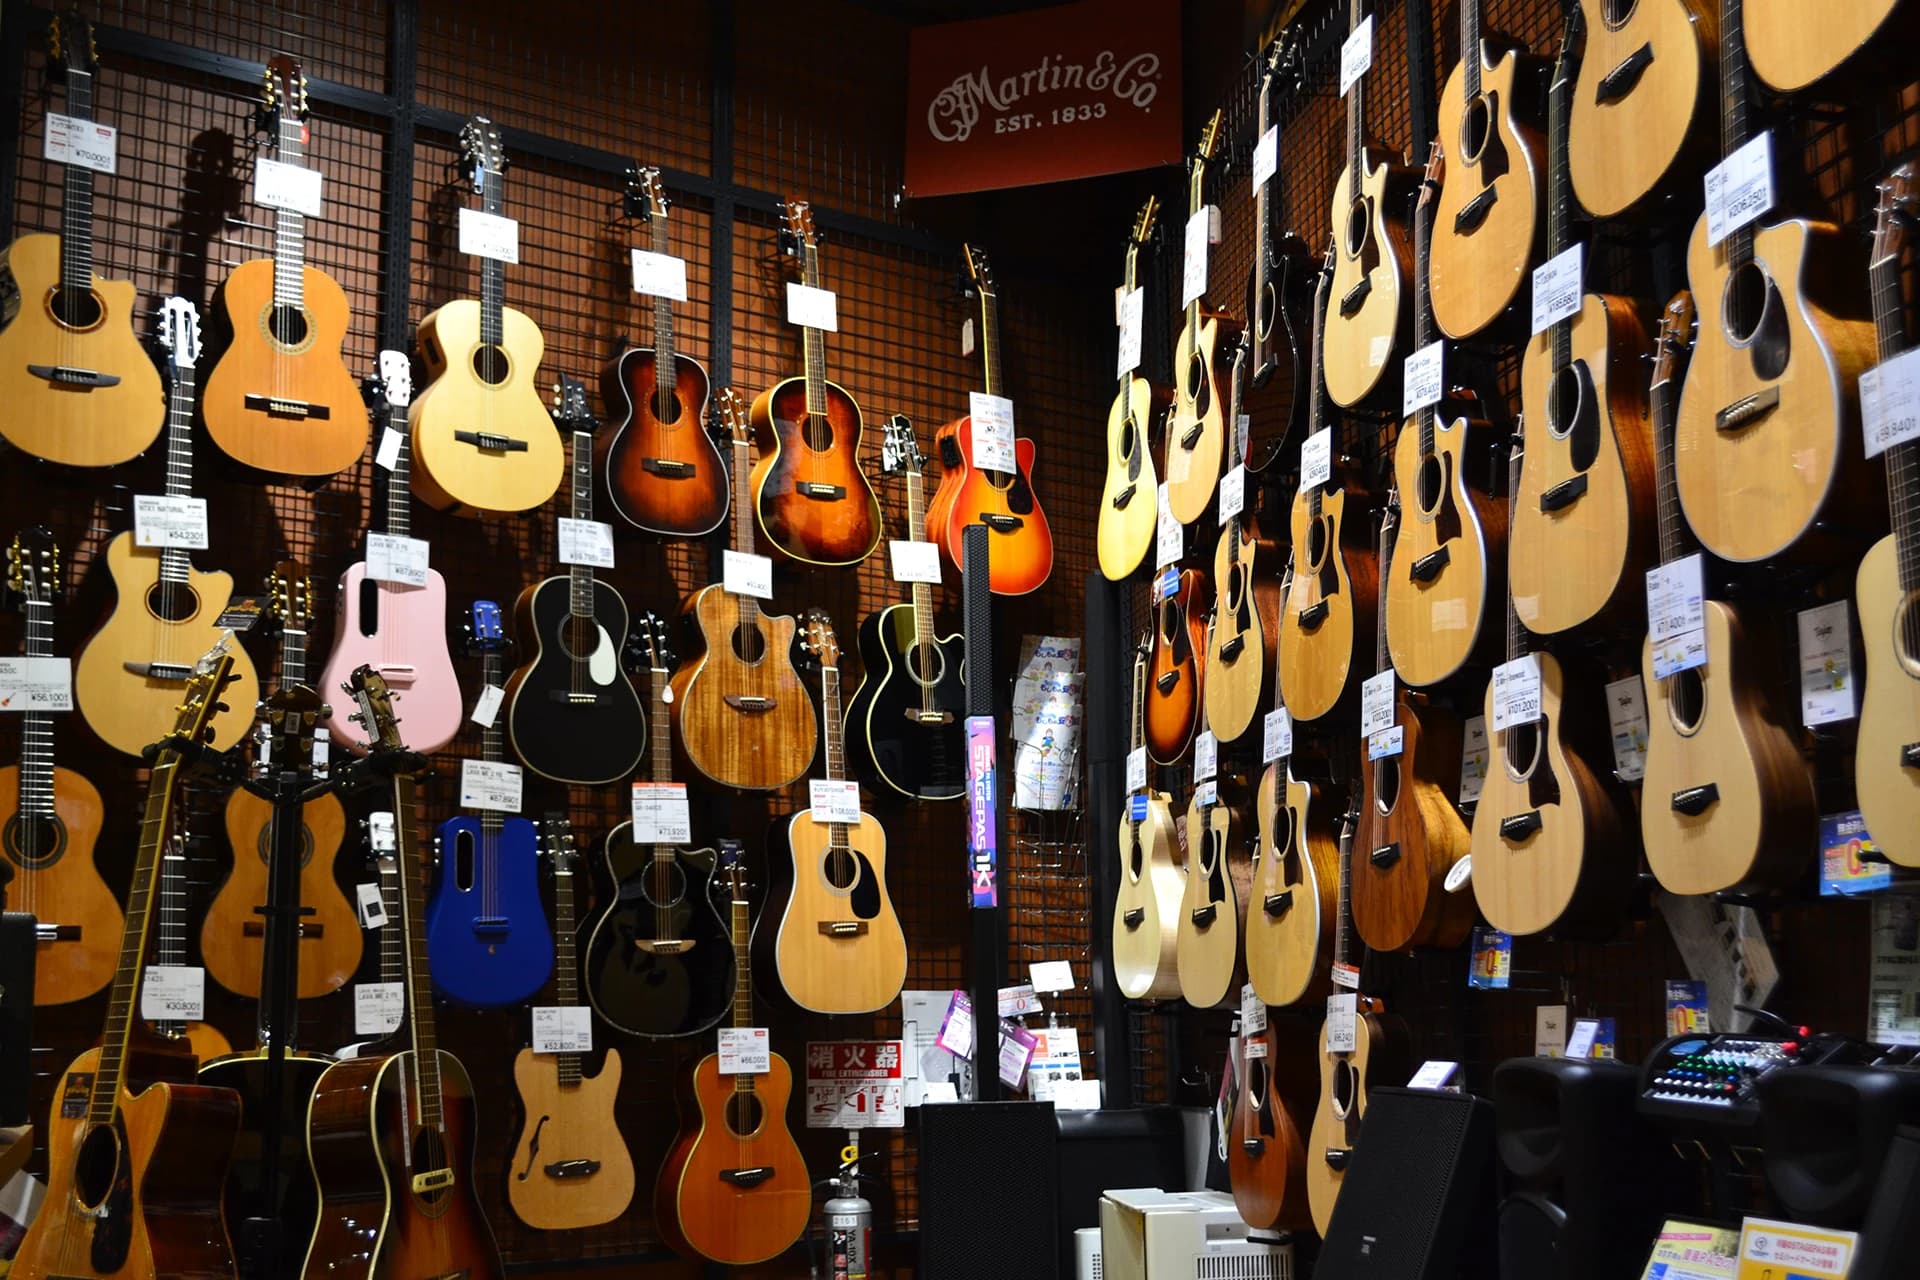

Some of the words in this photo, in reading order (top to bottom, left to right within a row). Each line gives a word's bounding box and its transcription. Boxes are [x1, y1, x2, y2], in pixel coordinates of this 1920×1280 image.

[994, 113, 1042, 134] EST.
[1051, 103, 1107, 125] 1833
[974, 745, 987, 851] STAGEPAS
[976, 852, 991, 889] 1K
[809, 1045, 899, 1069] 消火器
[848, 1230, 857, 1264] YA-10X
